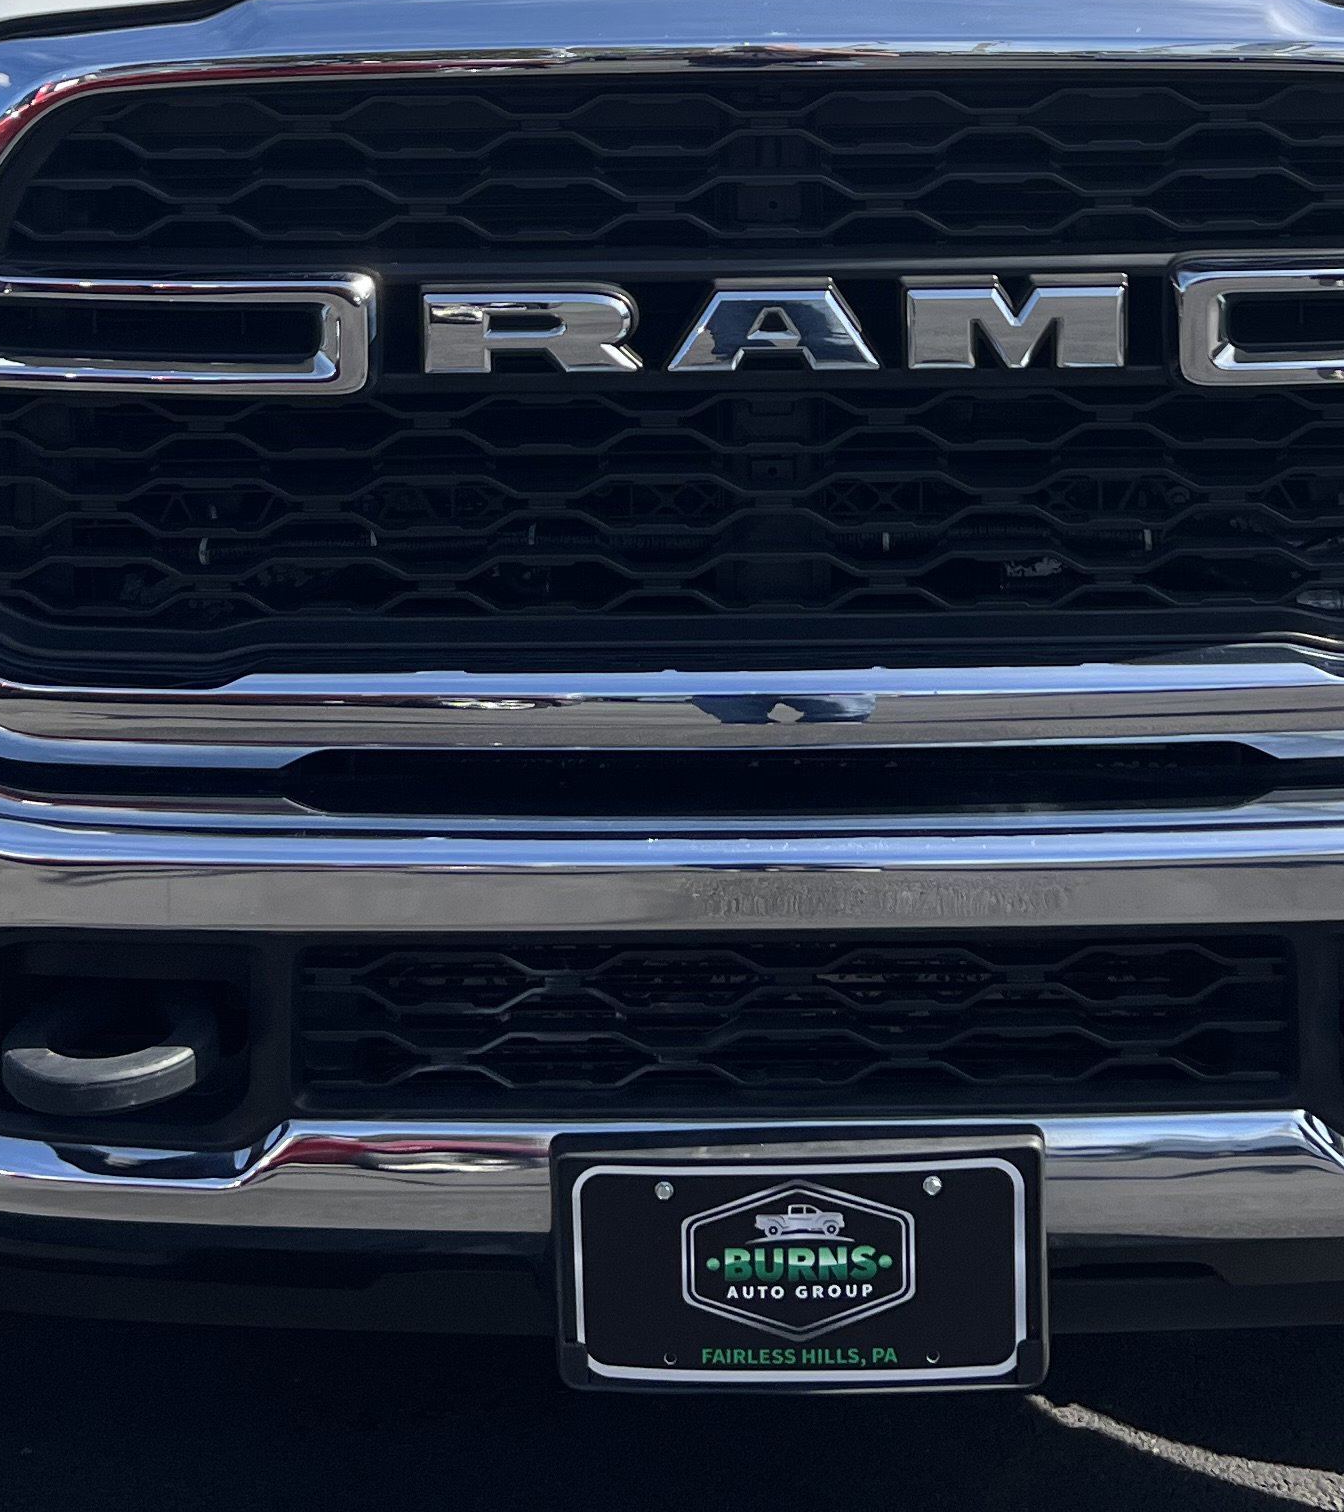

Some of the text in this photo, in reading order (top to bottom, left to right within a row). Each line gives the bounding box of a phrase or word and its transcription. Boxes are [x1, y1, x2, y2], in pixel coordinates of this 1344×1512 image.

[421, 275, 1129, 372] RAM
[723, 1244, 879, 1282] BURNS
[726, 1283, 874, 1299] AUTO GROUP
[701, 1346, 898, 1367] FAIRLESS HILLS, PA
